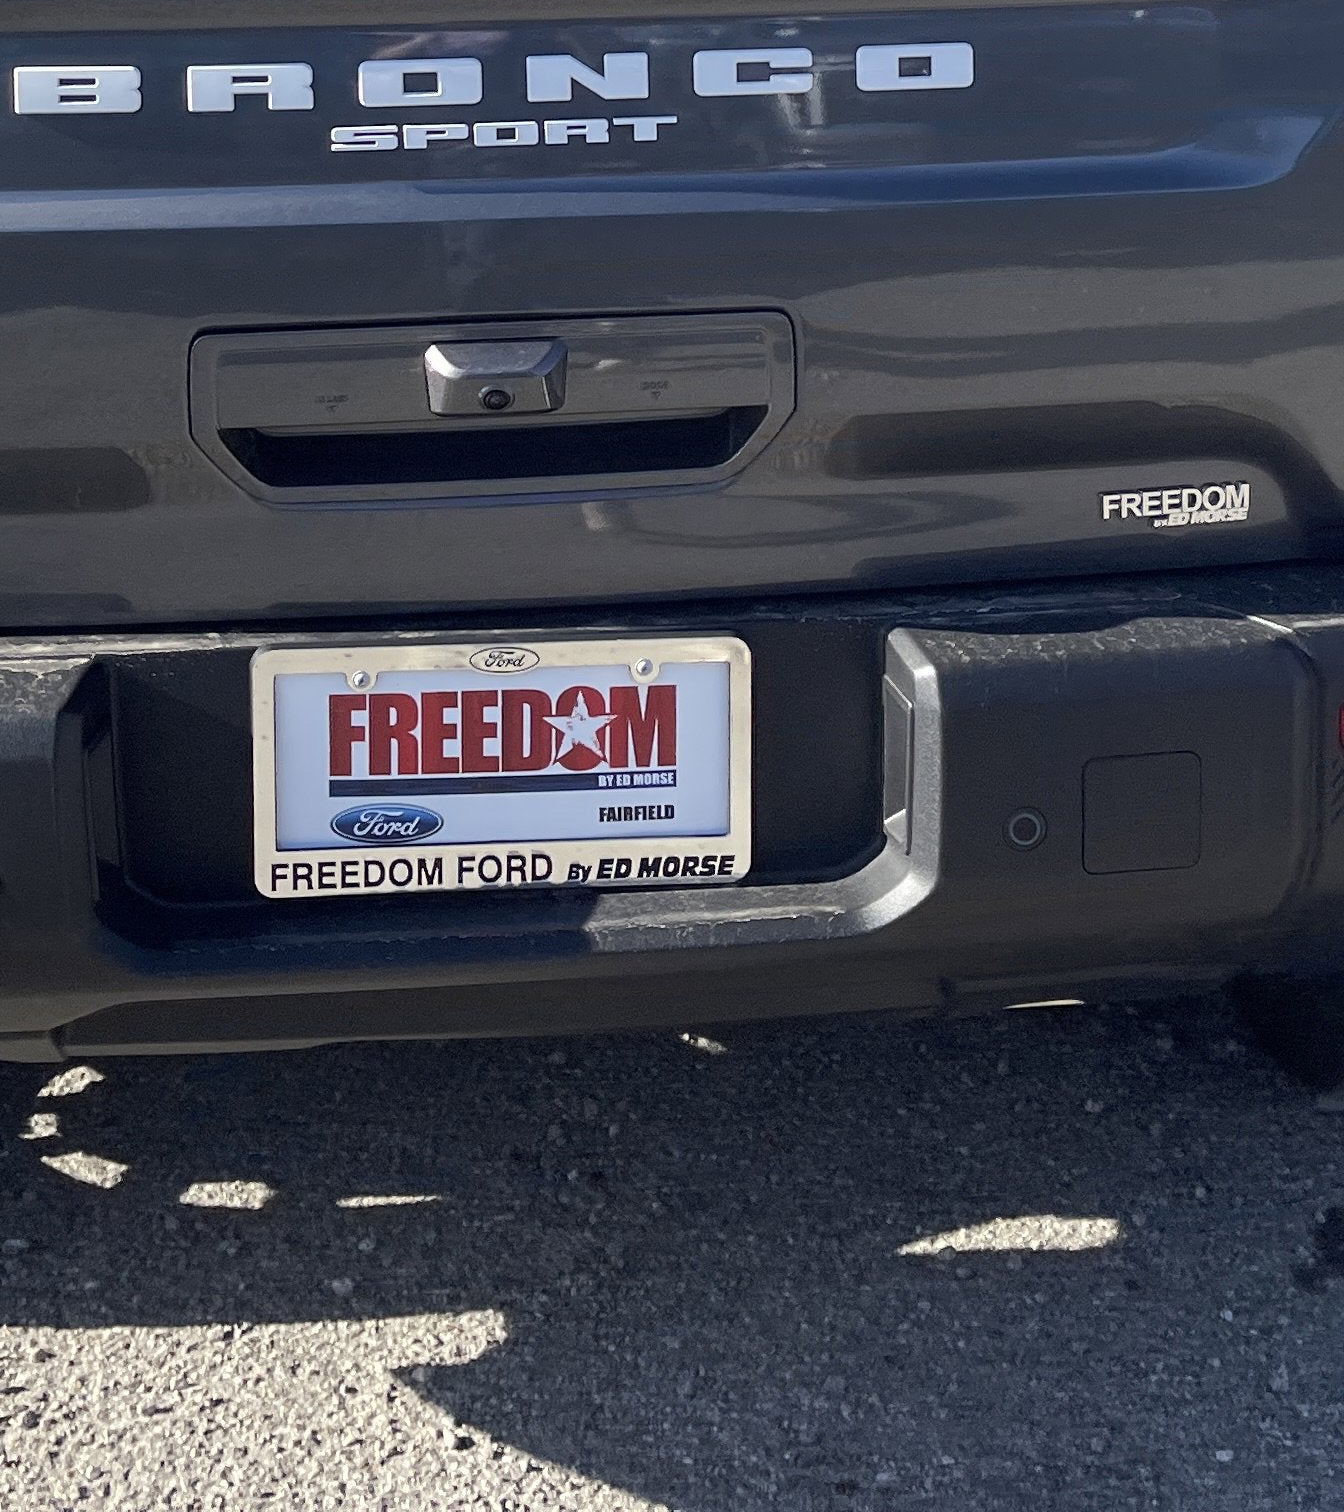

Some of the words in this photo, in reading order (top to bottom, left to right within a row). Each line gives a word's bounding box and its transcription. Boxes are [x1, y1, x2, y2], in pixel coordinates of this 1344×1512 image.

[12, 42, 975, 115] BRONCO
[330, 114, 678, 152] SPORT
[1102, 483, 1251, 520] FREEDOM
[484, 650, 526, 668] Ford
[328, 684, 677, 777] FREEDOM
[598, 774, 614, 787] BY
[616, 773, 631, 787] ED
[633, 772, 674, 786] MORSE
[353, 809, 421, 836] Ford
[599, 804, 675, 823] FAIRFIELD
[271, 857, 444, 892] FREEDOM
[457, 854, 553, 885] FORD
[596, 858, 632, 880] ED
[637, 854, 736, 879] MORSE
